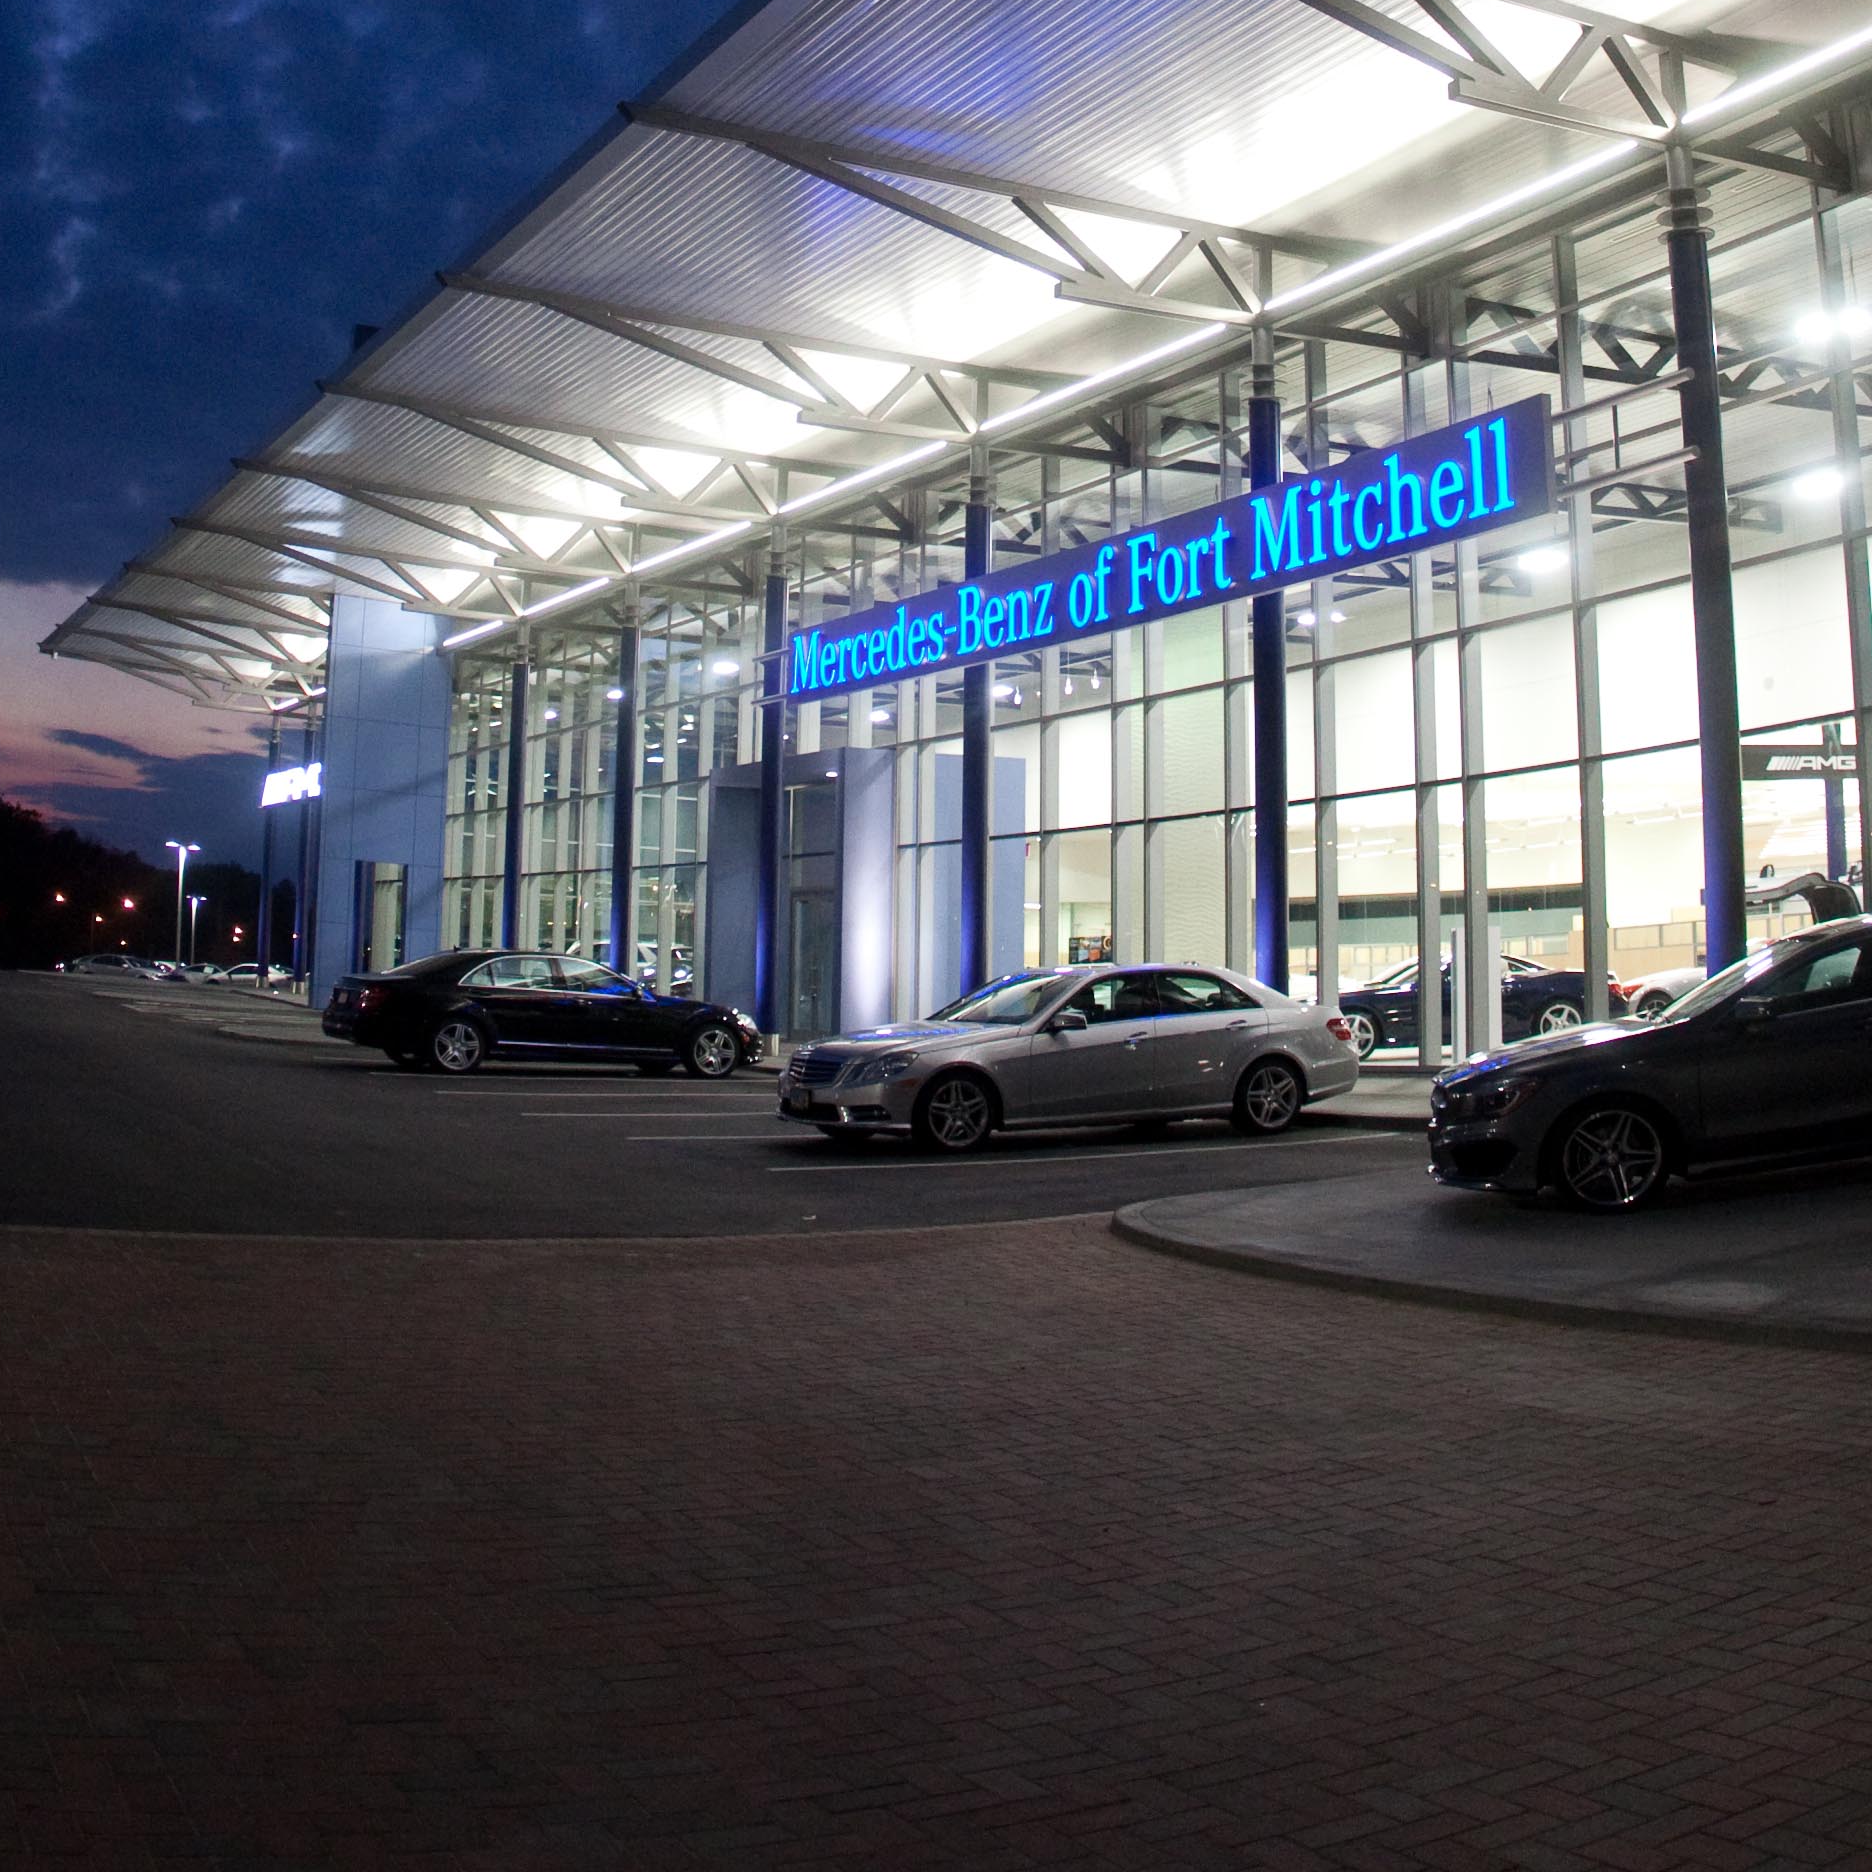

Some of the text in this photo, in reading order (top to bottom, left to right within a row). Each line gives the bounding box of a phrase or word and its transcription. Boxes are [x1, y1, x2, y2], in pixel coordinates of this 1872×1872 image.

[789, 414, 1516, 695] Mercedes-Benz of Fort Mitchell
